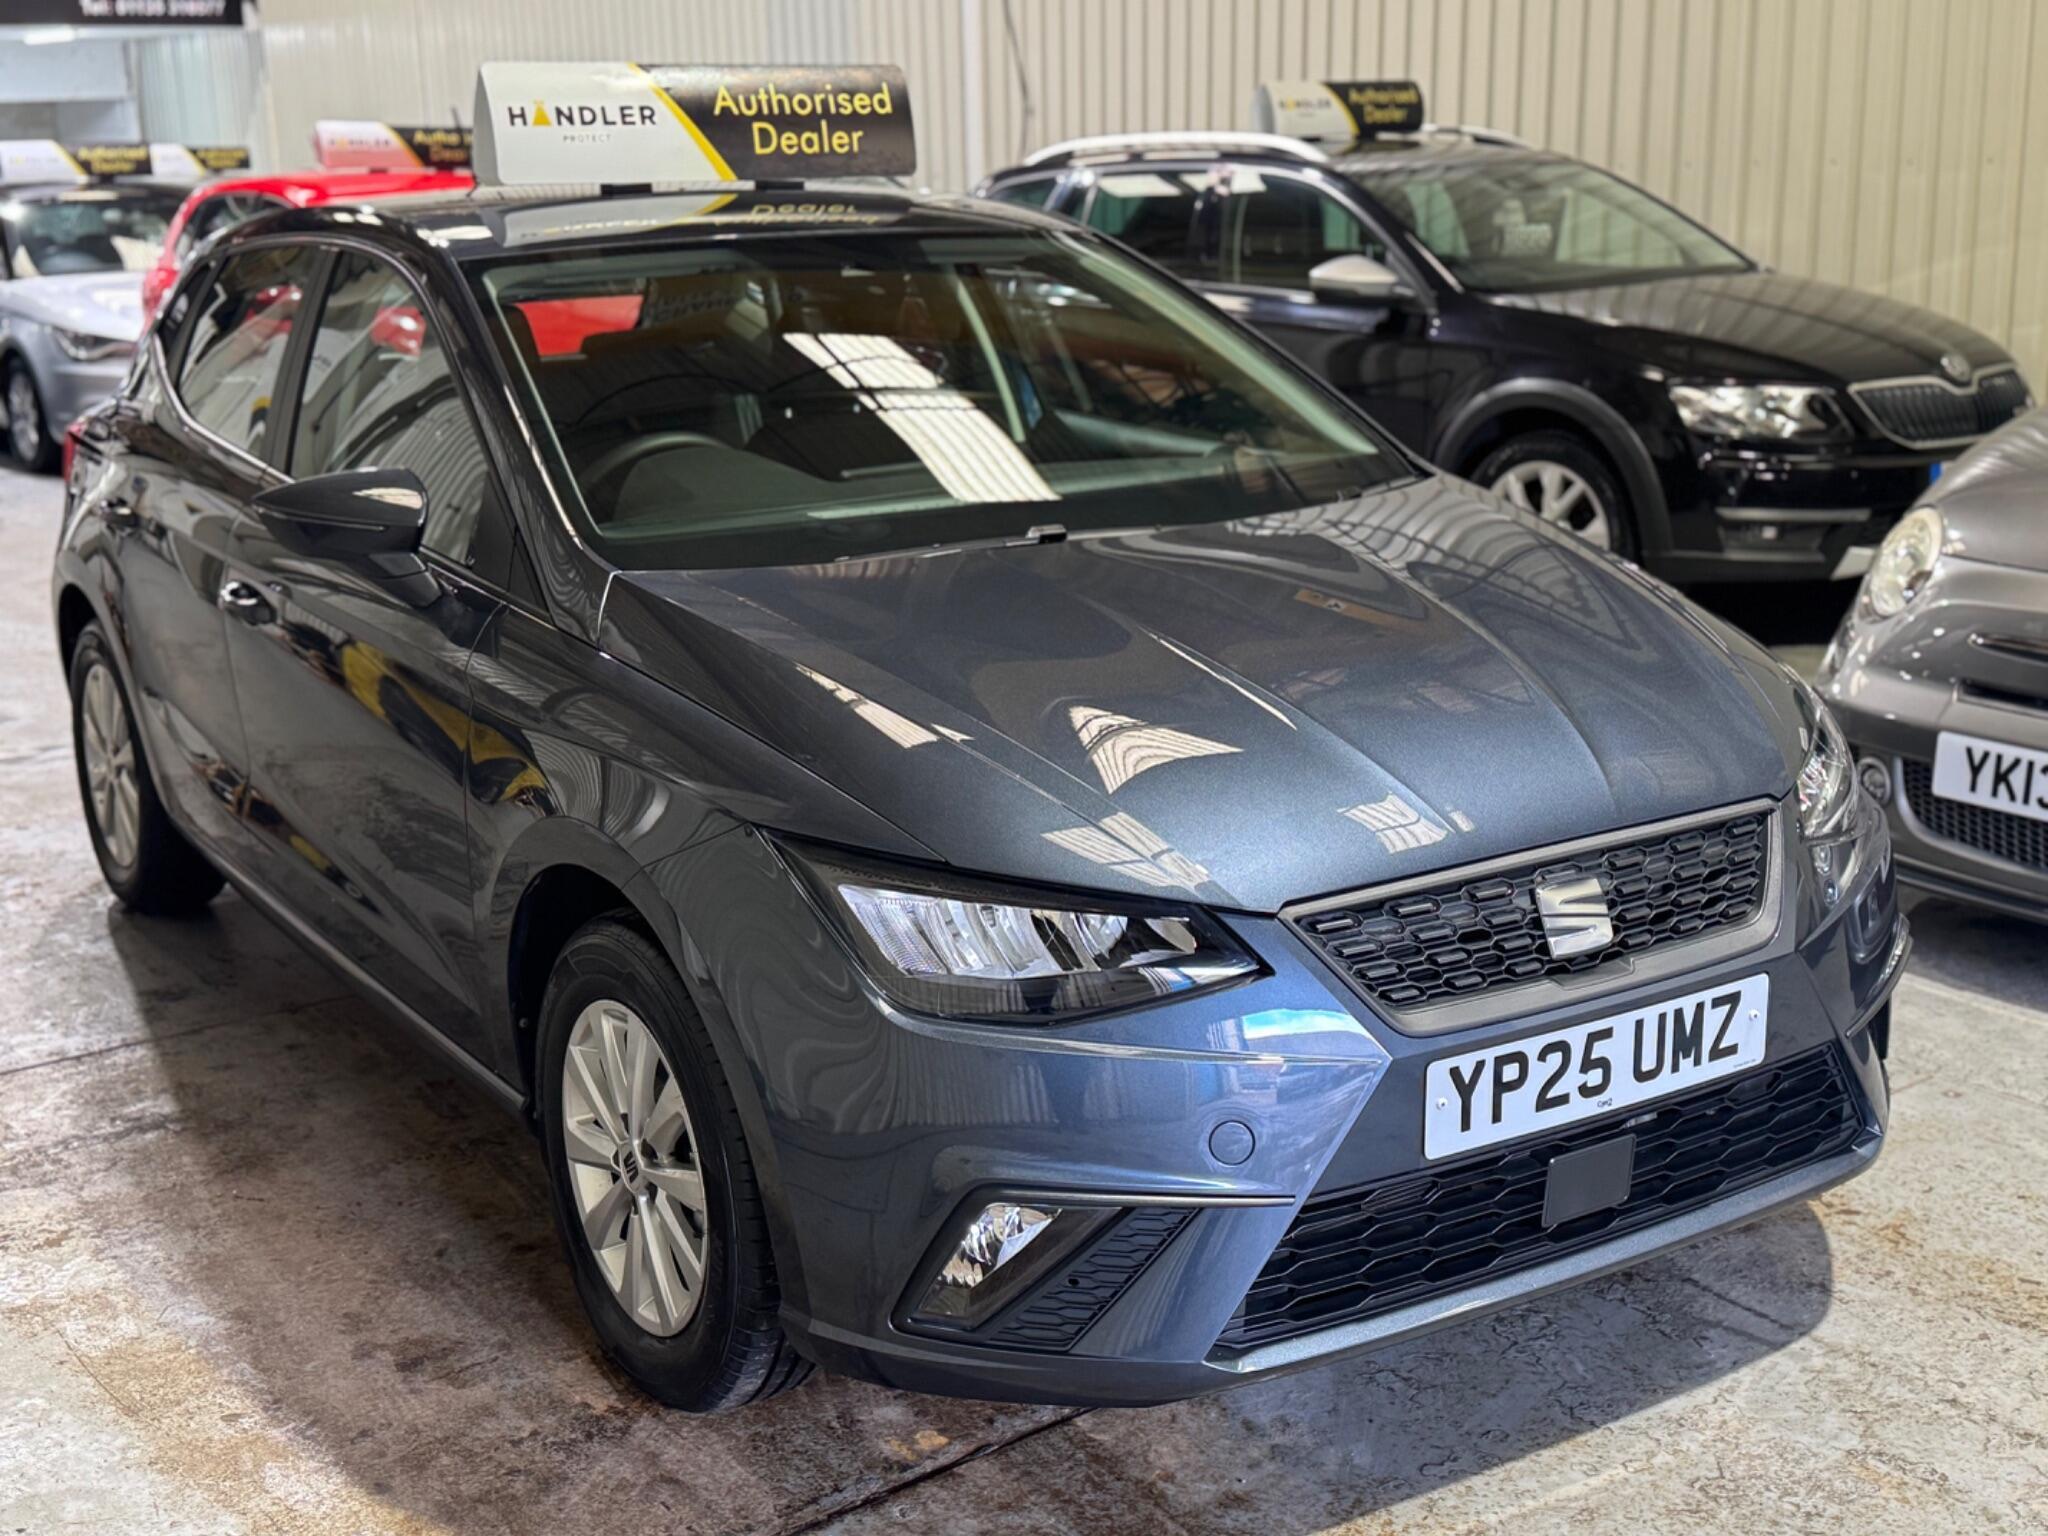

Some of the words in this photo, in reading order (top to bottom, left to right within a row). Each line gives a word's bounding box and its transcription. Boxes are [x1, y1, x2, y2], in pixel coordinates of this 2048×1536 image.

[713, 82, 893, 116] Authorised
[563, 134, 612, 143] PROTECT
[752, 119, 864, 155] Dealer
[1450, 1027, 1613, 1133] YP25
[1633, 990, 1742, 1083] UMZ
